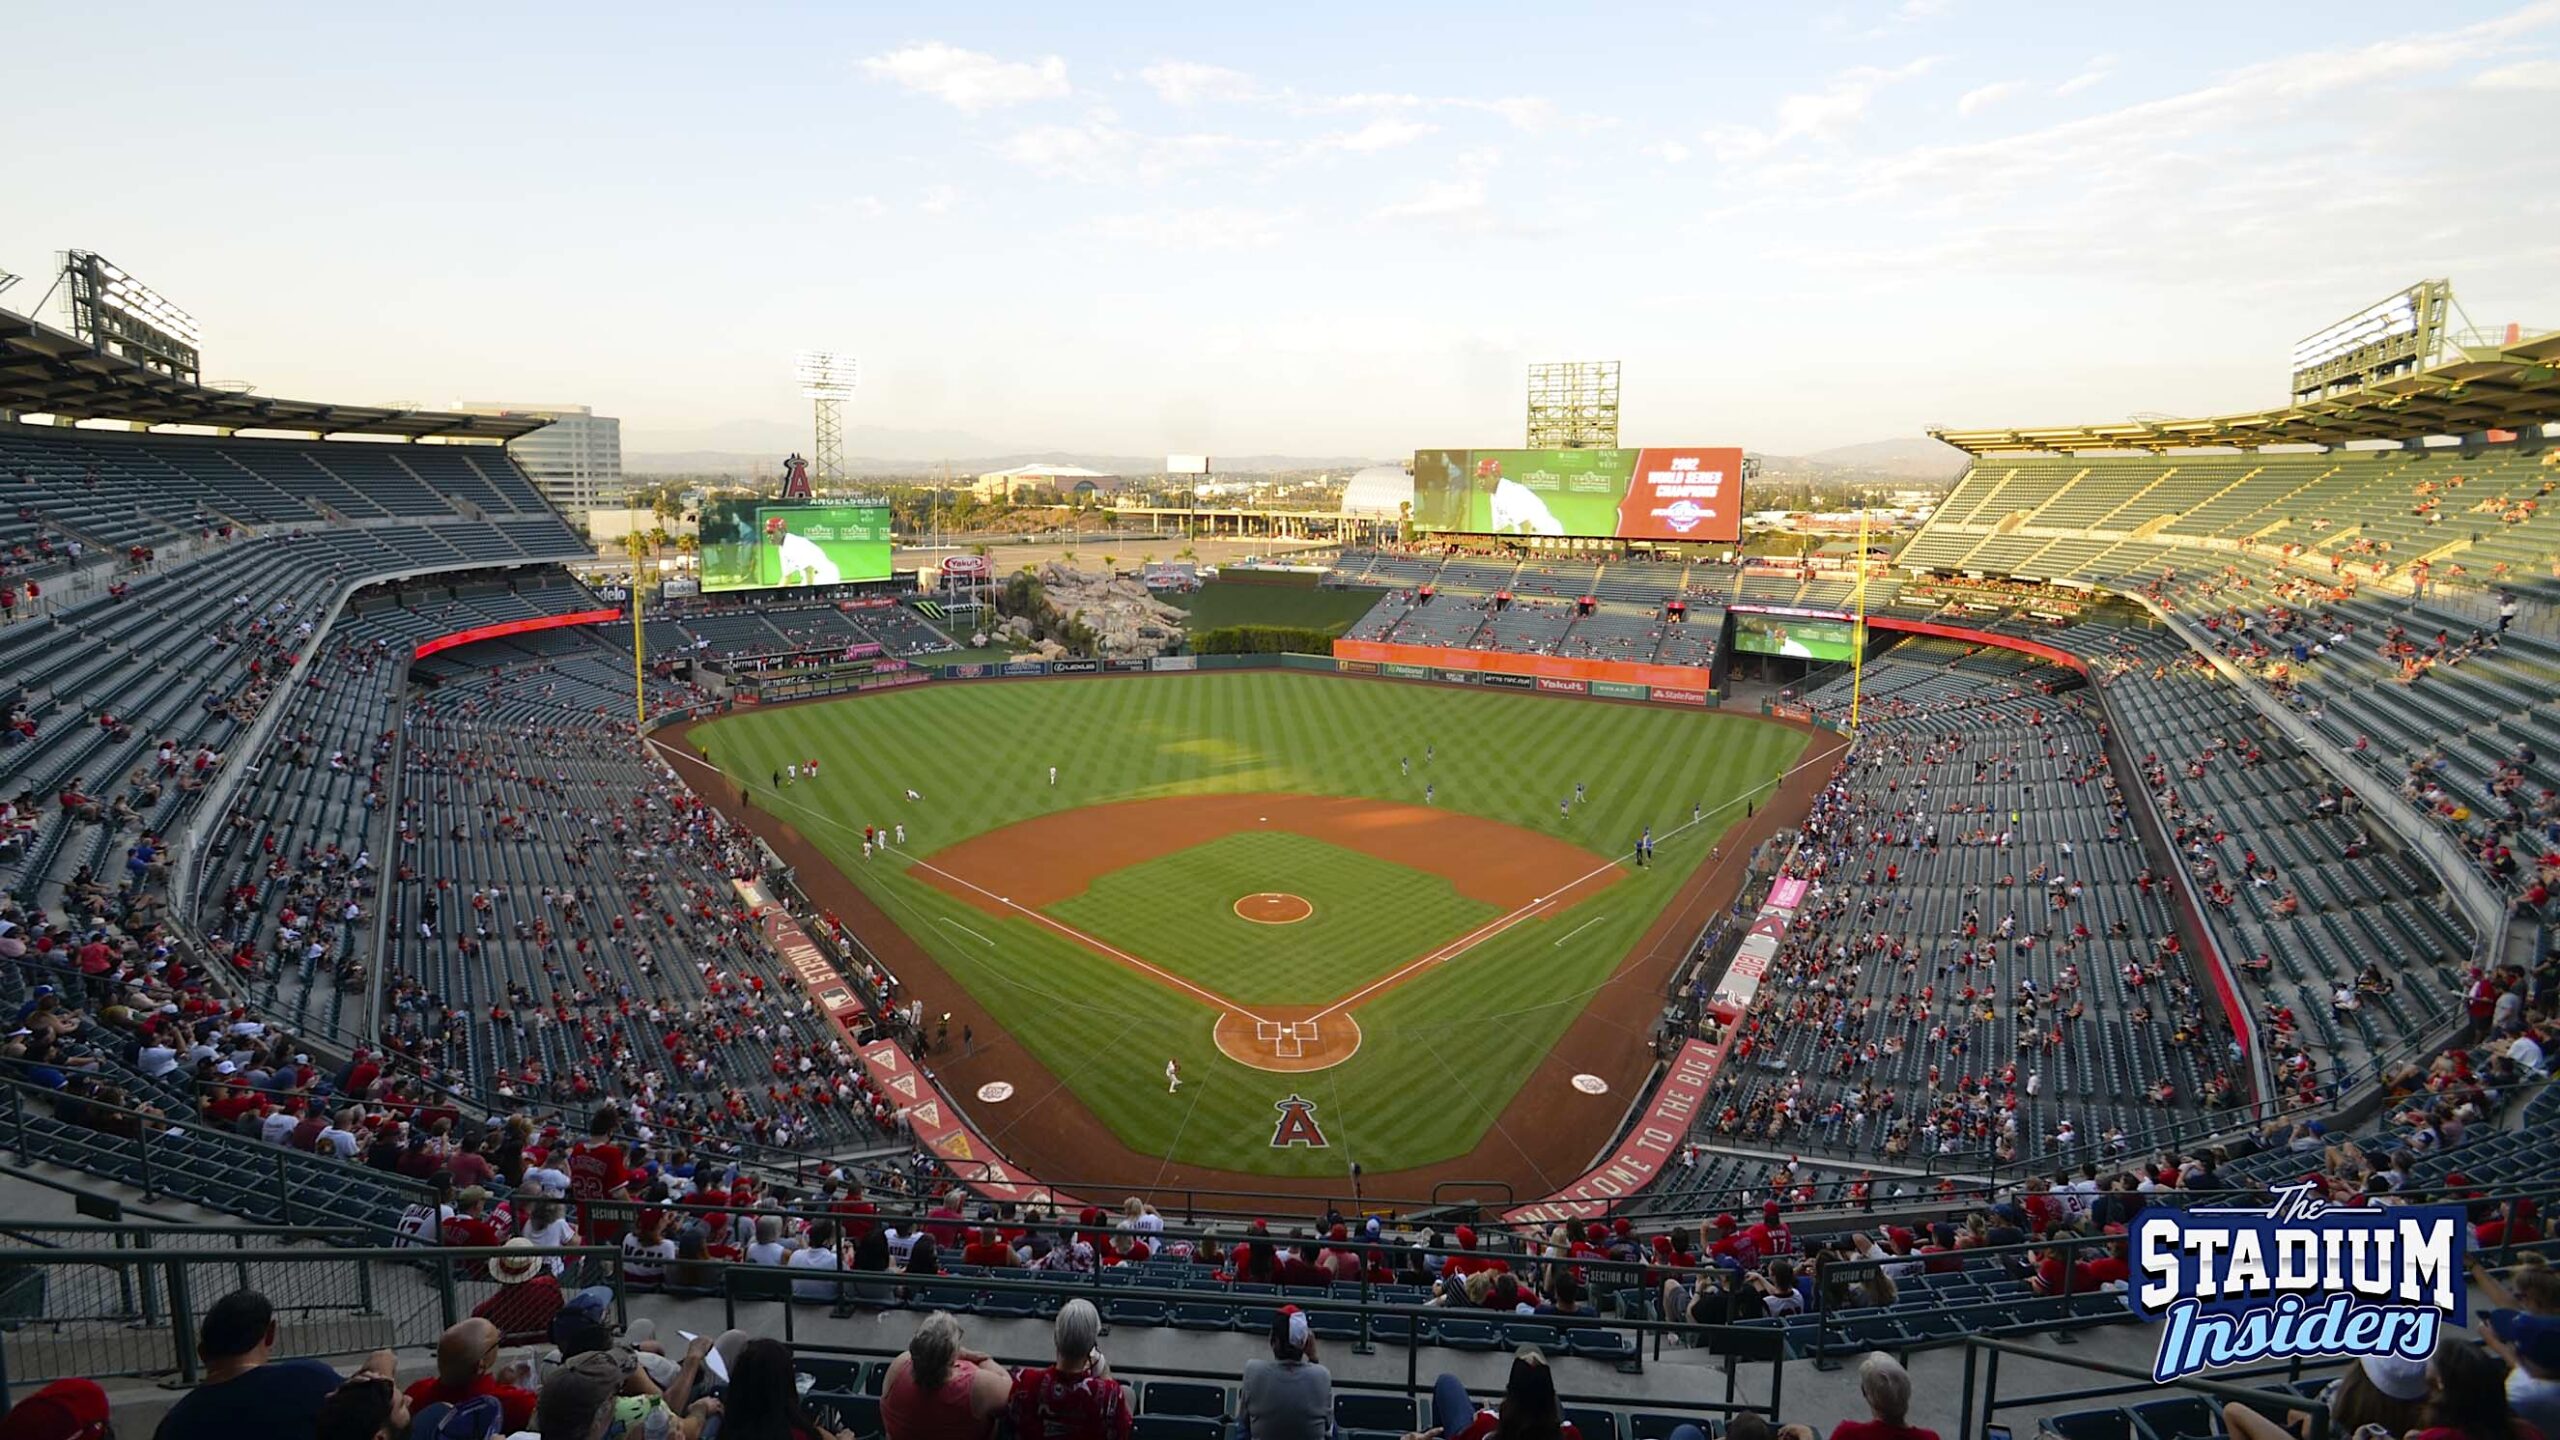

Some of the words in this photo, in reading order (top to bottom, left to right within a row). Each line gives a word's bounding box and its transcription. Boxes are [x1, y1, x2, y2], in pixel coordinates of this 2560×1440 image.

[951, 559, 979, 567] Yakult
[1540, 679, 1584, 691] Yakult
[784, 943, 838, 985] ANGELS
[1691, 1045, 1719, 1059] A
[1676, 1058, 1713, 1088] BIG
[1657, 1089, 1696, 1121] THE
[1269, 1093, 1330, 1148] A
[1636, 1127, 1674, 1152] TO
[1515, 1154, 1652, 1232] WELCOME
[590, 1207, 620, 1220] SECTION
[1772, 1238, 1787, 1254] 17
[1590, 1270, 1622, 1283] SECTION
[1831, 1270, 1861, 1283] SECTION
